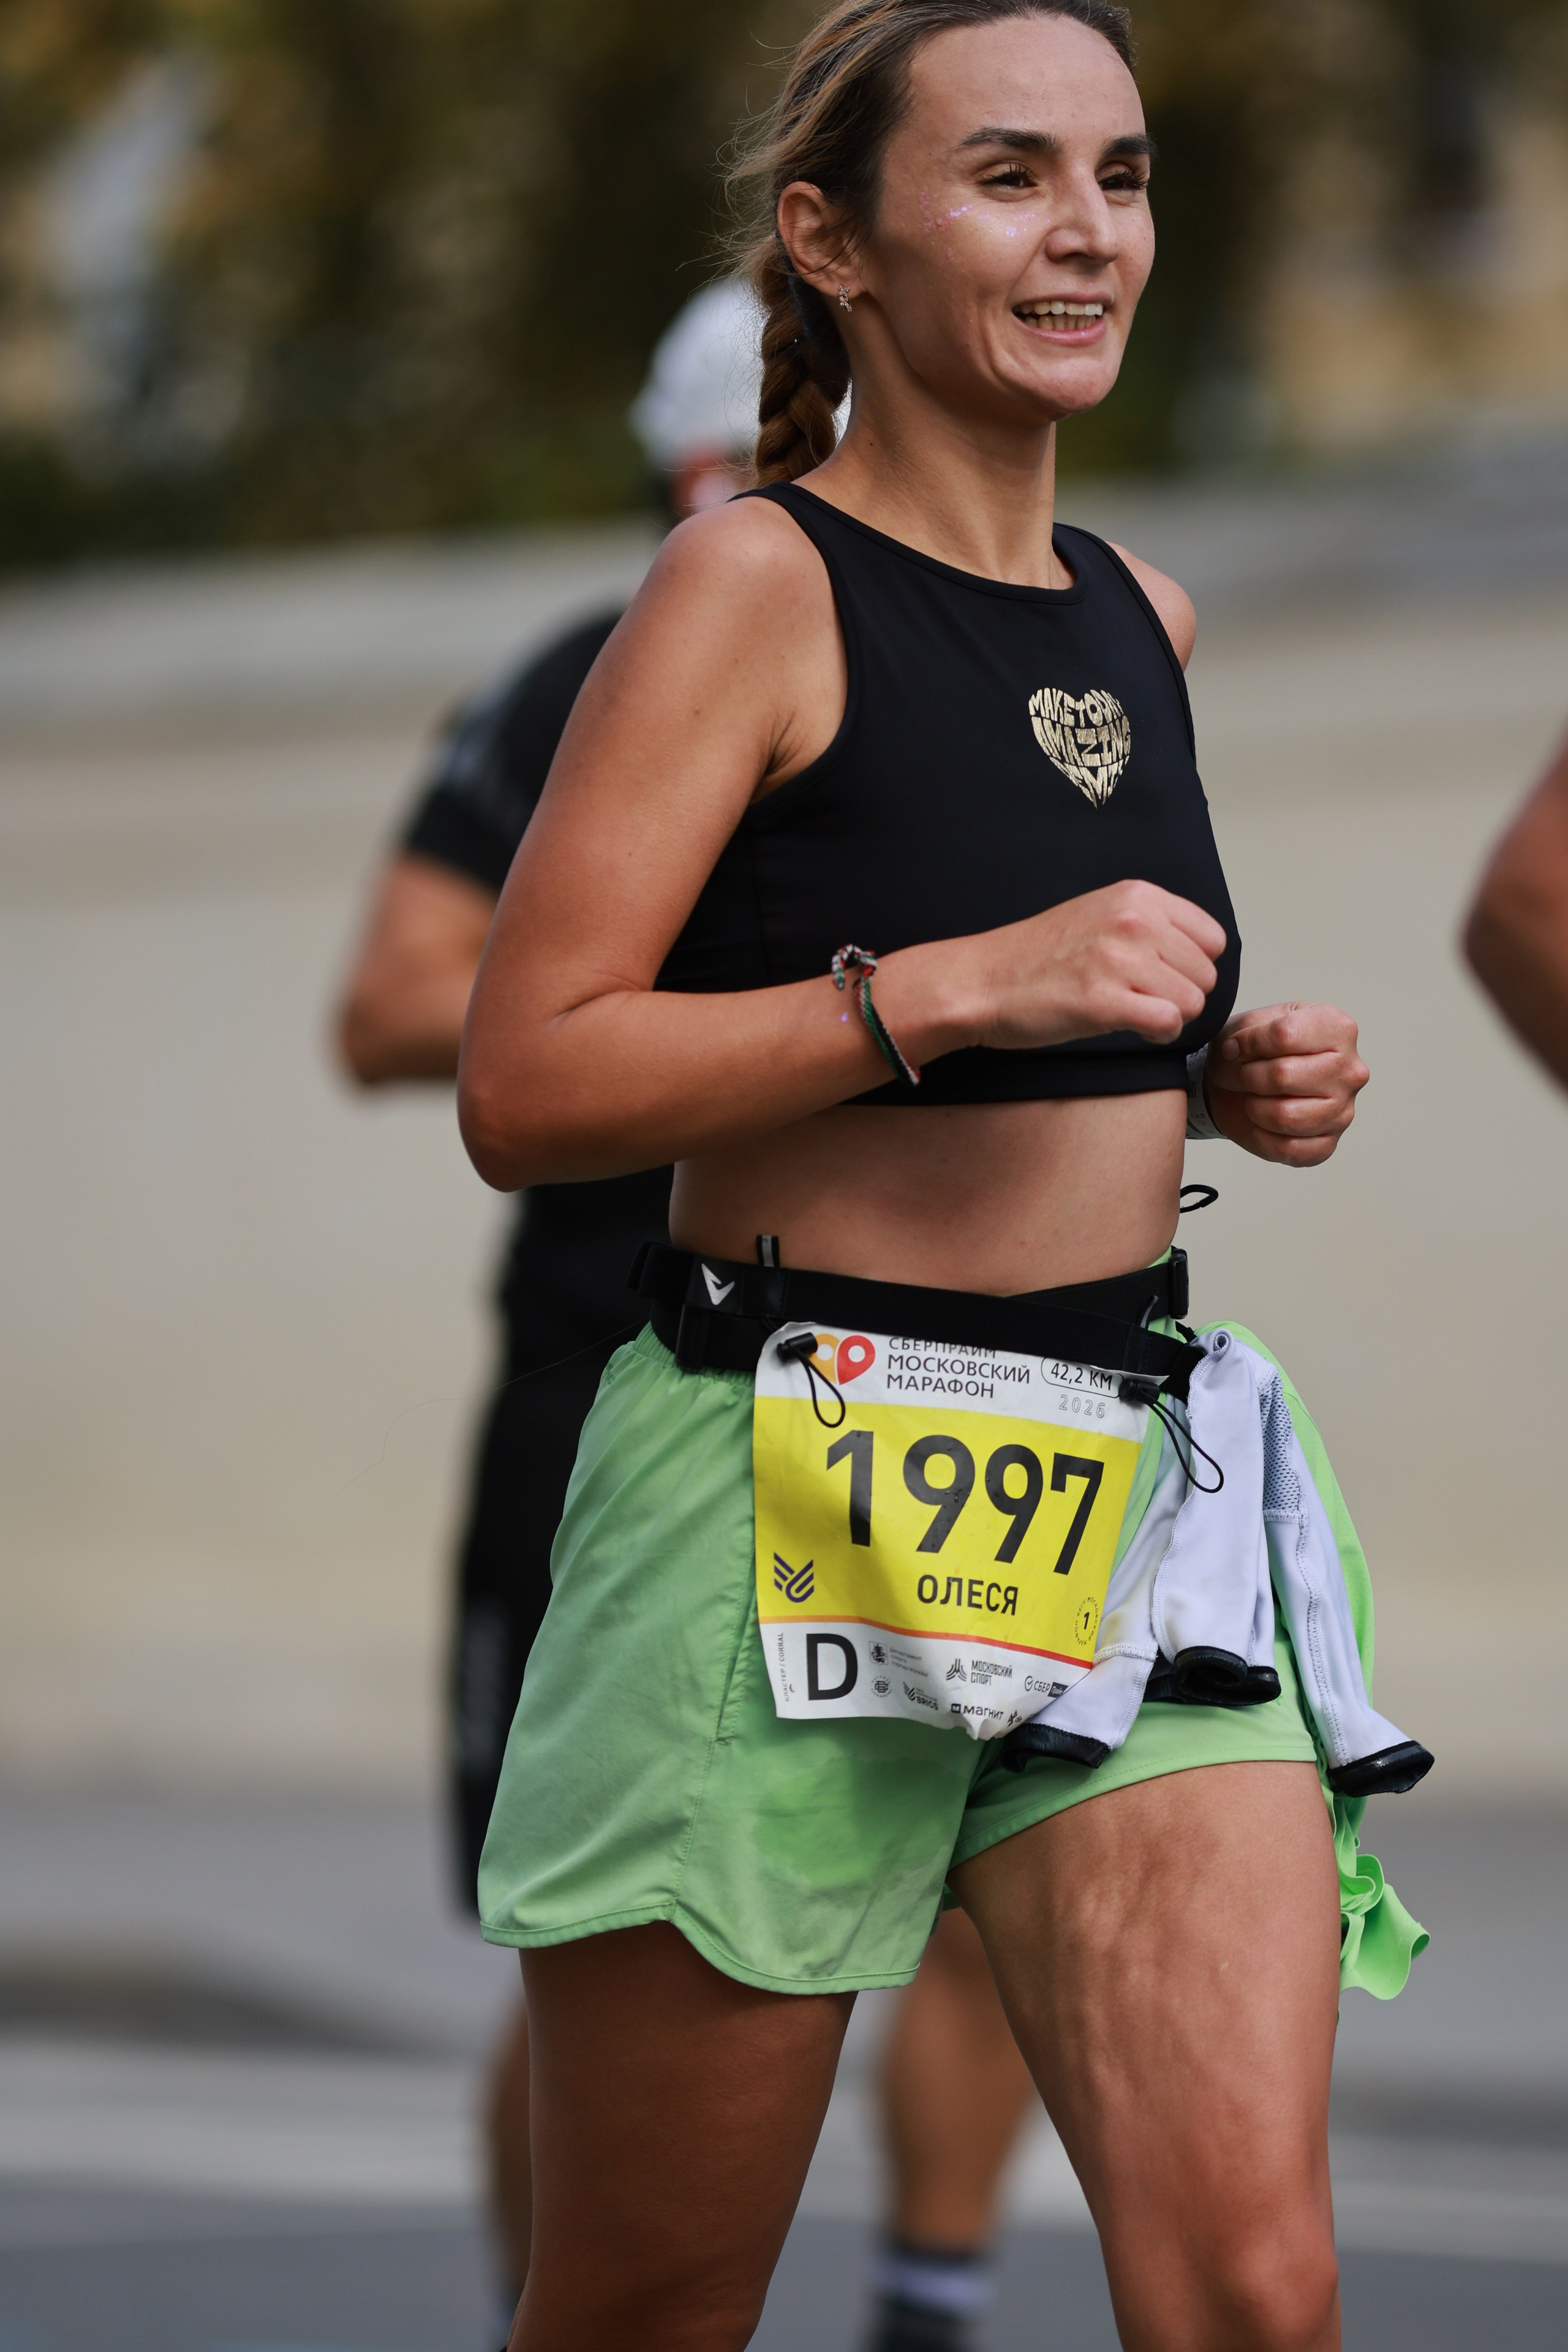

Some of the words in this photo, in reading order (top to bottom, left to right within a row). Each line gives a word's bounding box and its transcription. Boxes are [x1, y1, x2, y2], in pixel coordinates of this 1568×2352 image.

[1028, 687, 1075, 728] MAKE
[1075, 689, 1125, 728] TODAY
[1031, 715, 1131, 767] AMAZING
[888, 1354, 1030, 1384] МОСКОВСКИЙ
[1050, 1362, 1084, 1384] 42,2
[1089, 1370, 1114, 1391] КМ
[887, 1374, 994, 1398] МАРАФОН
[1058, 1394, 1106, 1419] 2026
[826, 1430, 1105, 1576] 1997
[918, 1574, 1019, 1616] ОЛЕСЯ
[1084, 1611, 1090, 1630] 1
[805, 1633, 859, 1701] D
[970, 1672, 992, 1686] СПОРТ
[971, 1660, 1012, 1678] МОСКОВСКИЙ
[780, 1668, 790, 1702] КЛАСТЕР
[1033, 1680, 1051, 1693] СБЕР
[916, 1696, 938, 1711] BRICS
